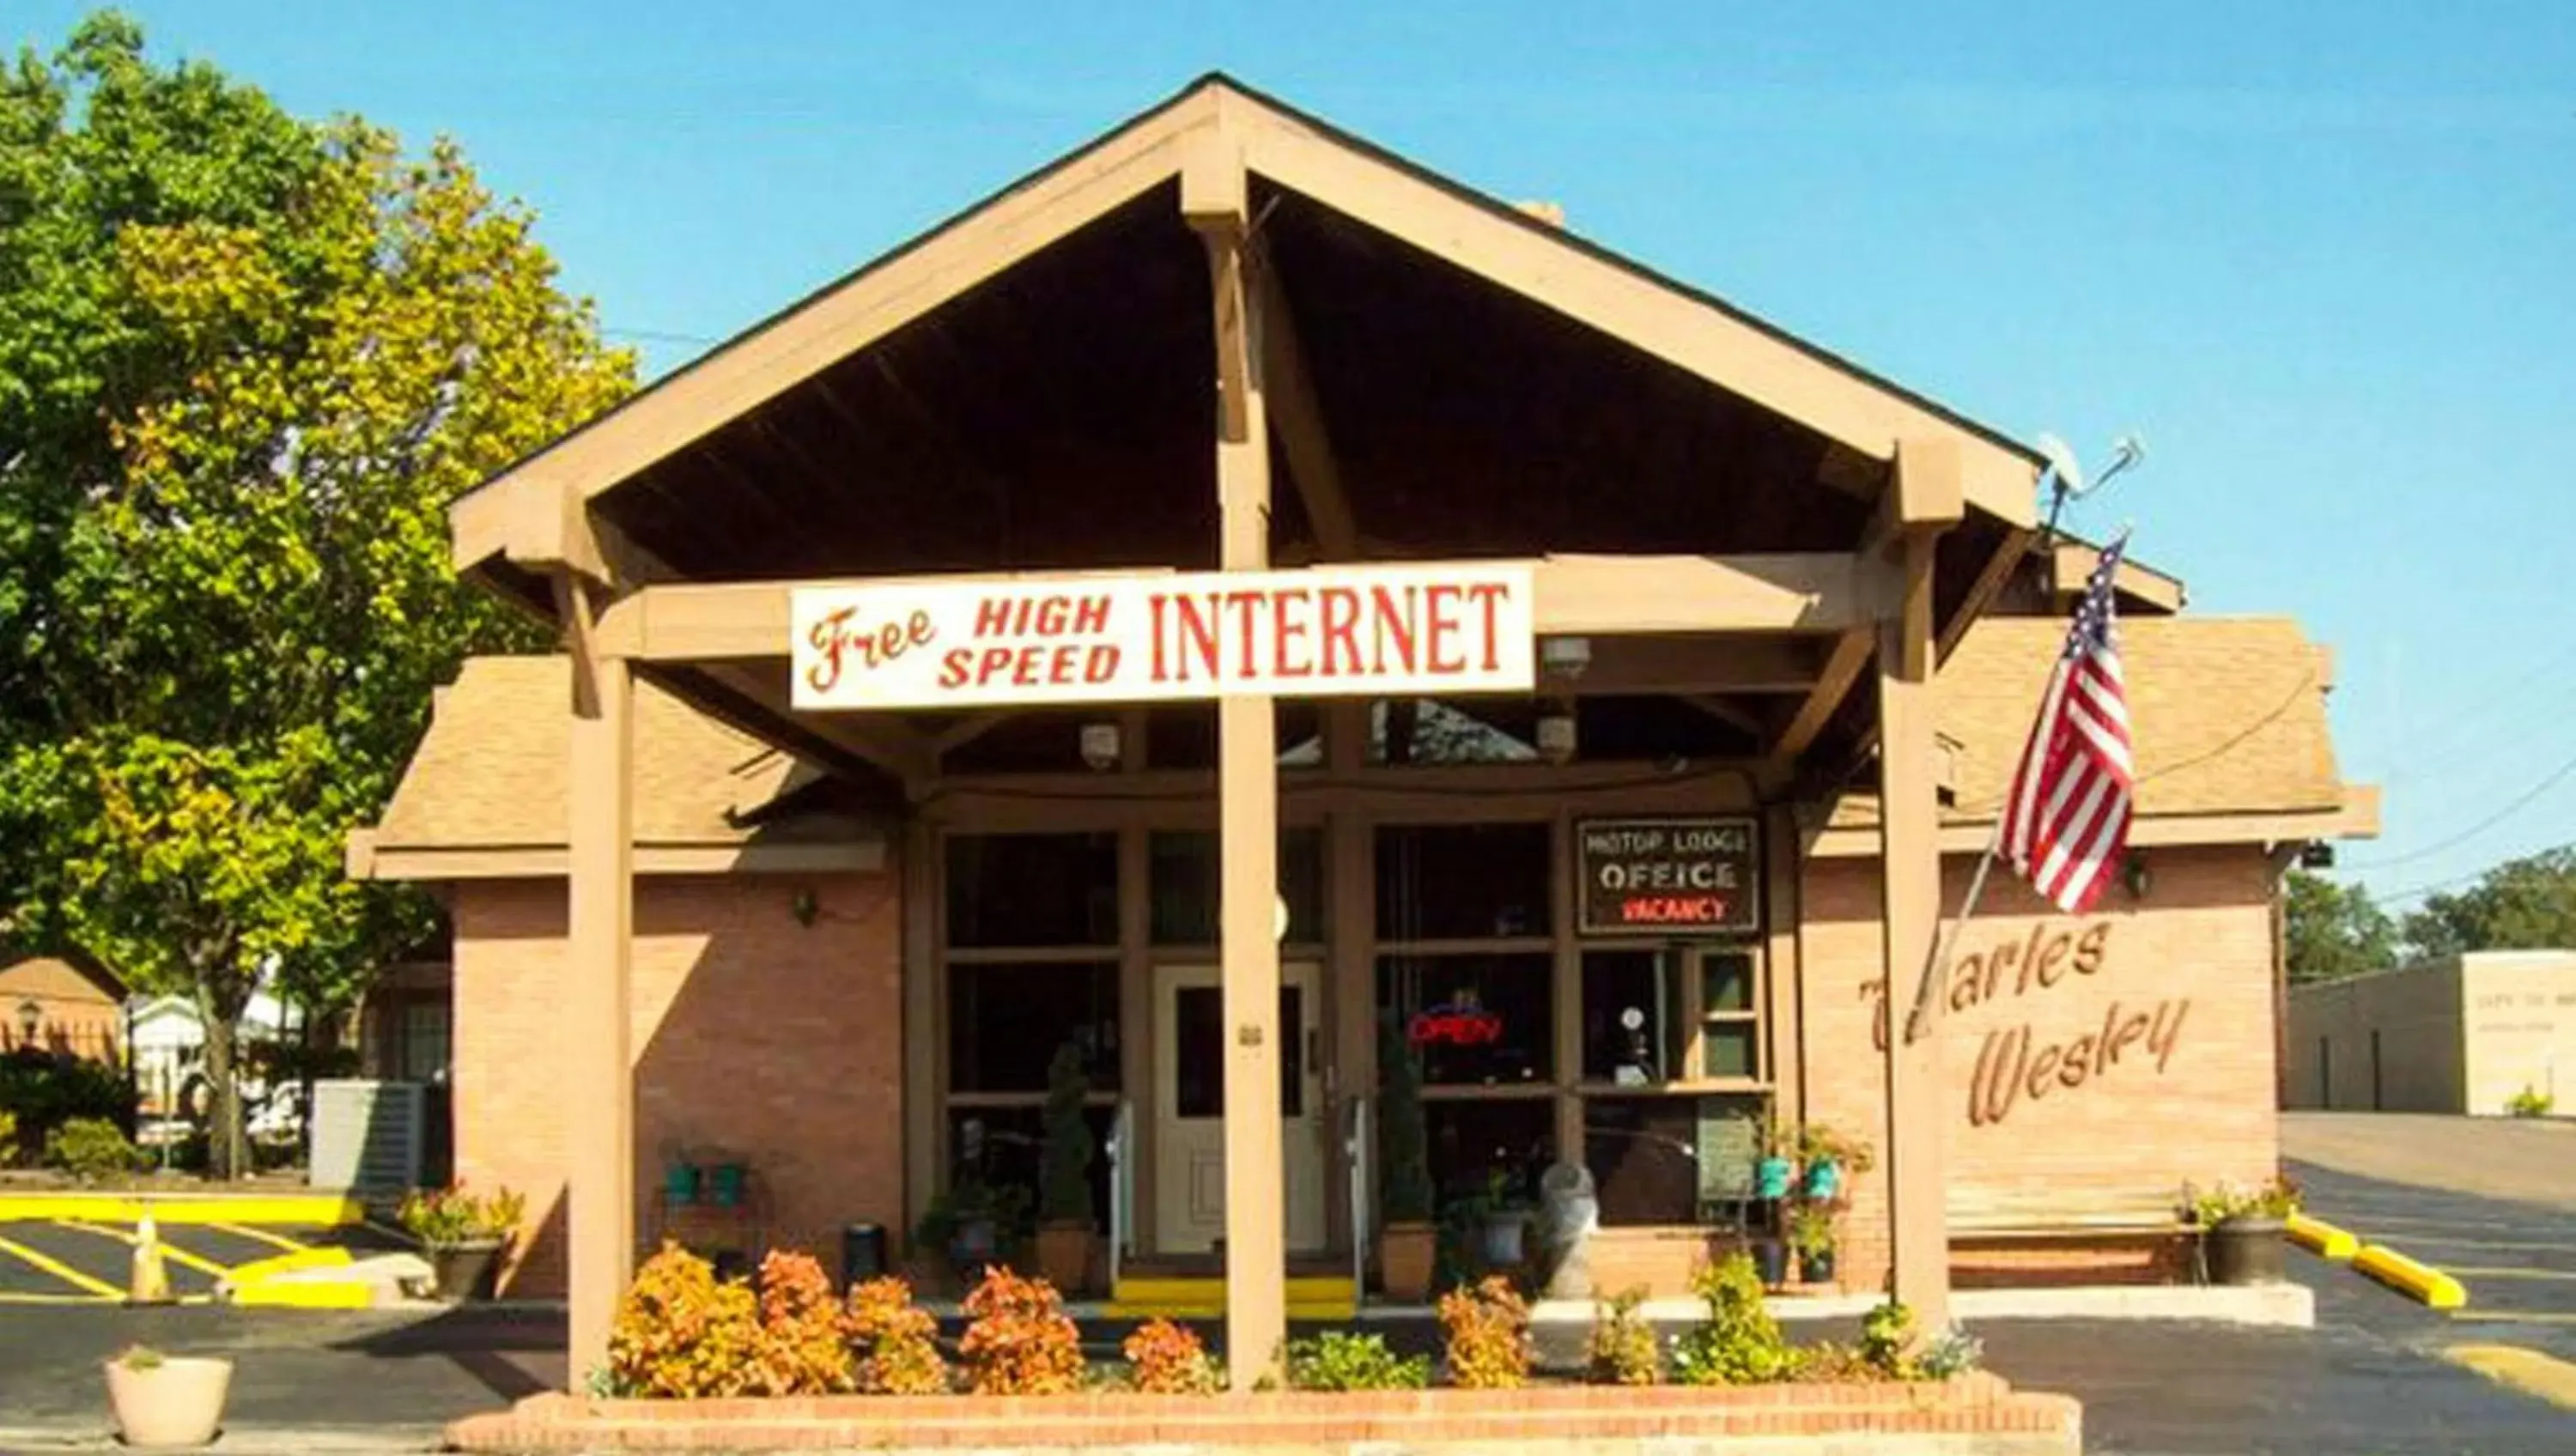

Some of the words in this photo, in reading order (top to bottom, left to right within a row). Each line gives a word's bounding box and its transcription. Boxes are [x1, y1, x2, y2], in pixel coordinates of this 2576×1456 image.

[974, 595, 1111, 638] HIGH
[1148, 582, 1510, 682] INTERNET
[806, 605, 938, 694] Free
[939, 645, 1121, 688] SPEED
[1599, 862, 1738, 890] OFFICE
[1623, 896, 1728, 921] VACANCY
[1859, 921, 2111, 1053] arles
[1406, 1013, 1503, 1044] OPEN
[1967, 999, 2190, 1128] Wesley
